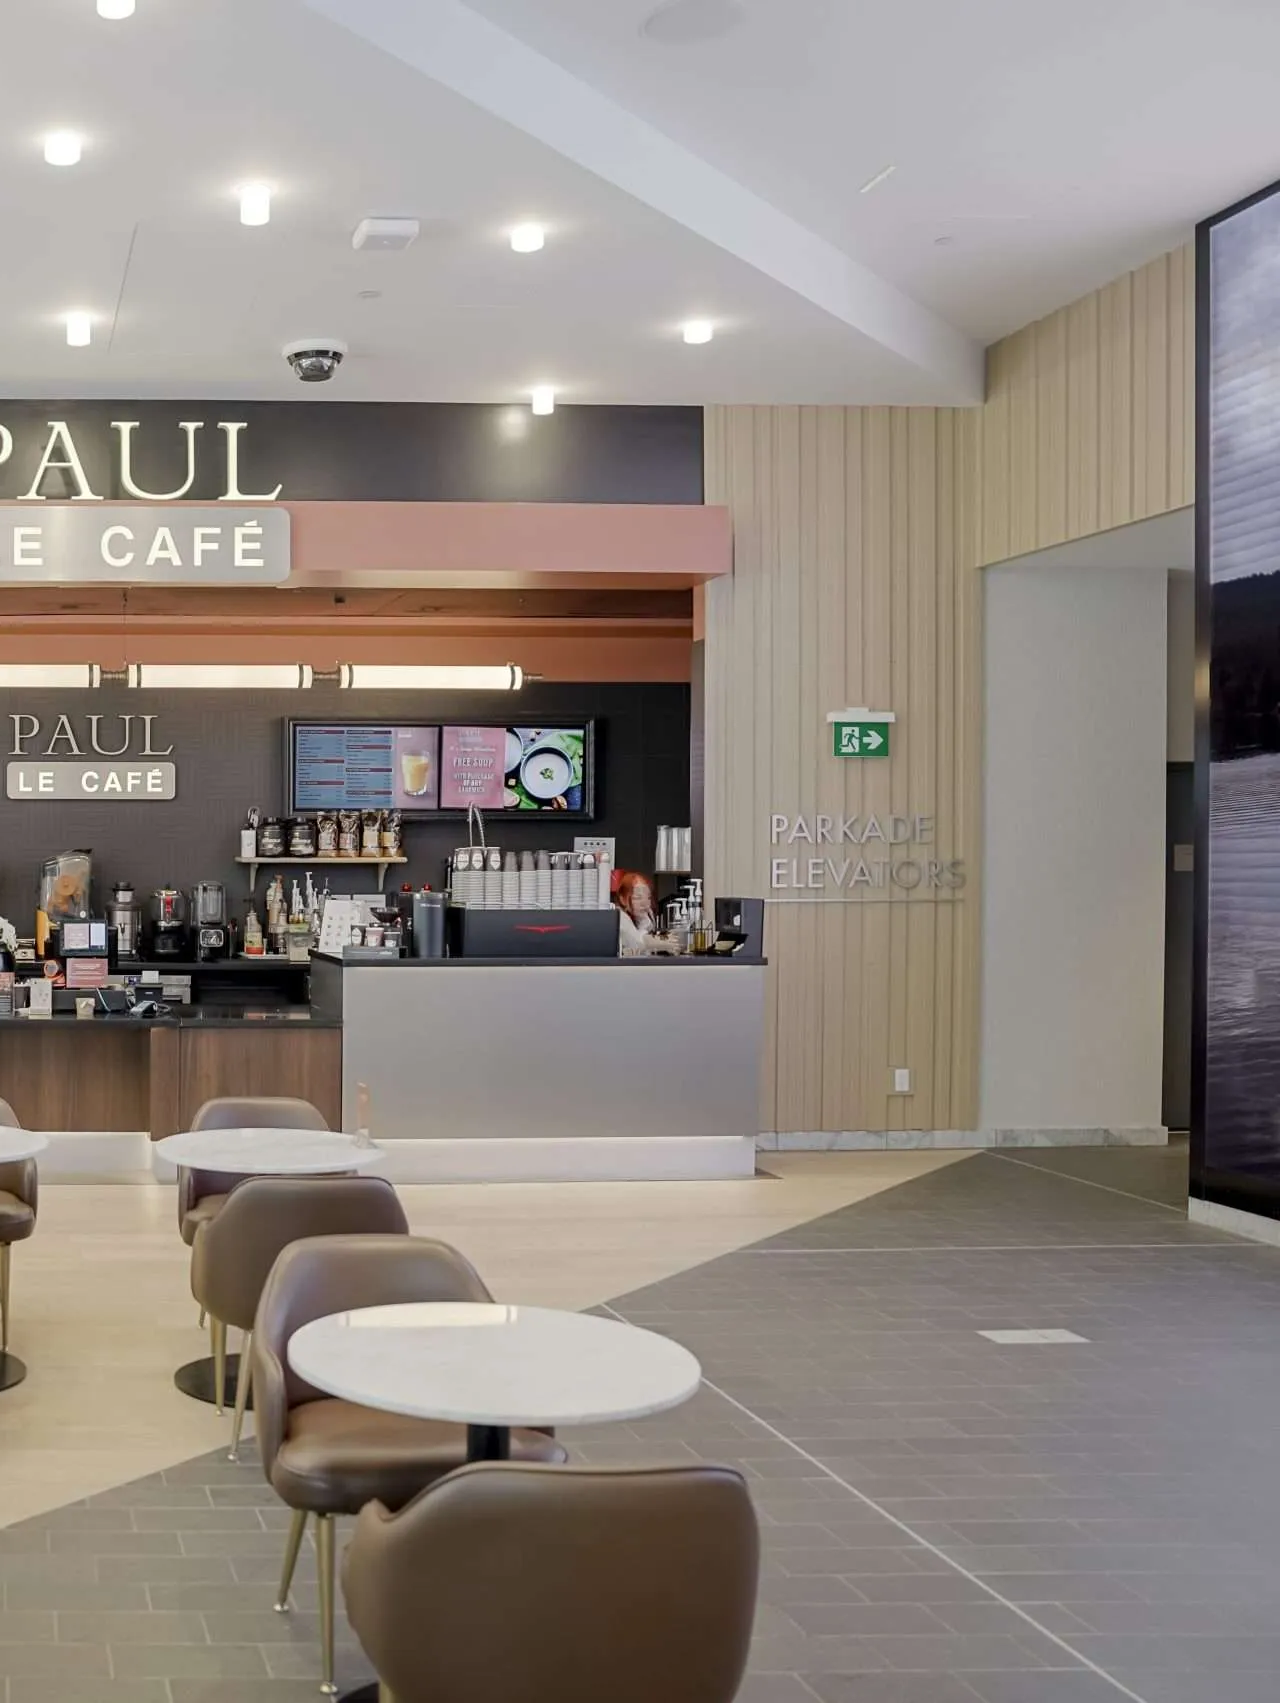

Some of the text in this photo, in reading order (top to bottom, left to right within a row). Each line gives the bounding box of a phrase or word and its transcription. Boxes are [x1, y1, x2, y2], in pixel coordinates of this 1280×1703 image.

[100, 519, 265, 568] CAFÉ
[7, 714, 174, 756] PAUL
[19, 768, 163, 793] LE CAFÉ
[770, 813, 935, 845] PARKADE
[770, 856, 967, 890] ELEVATORS
